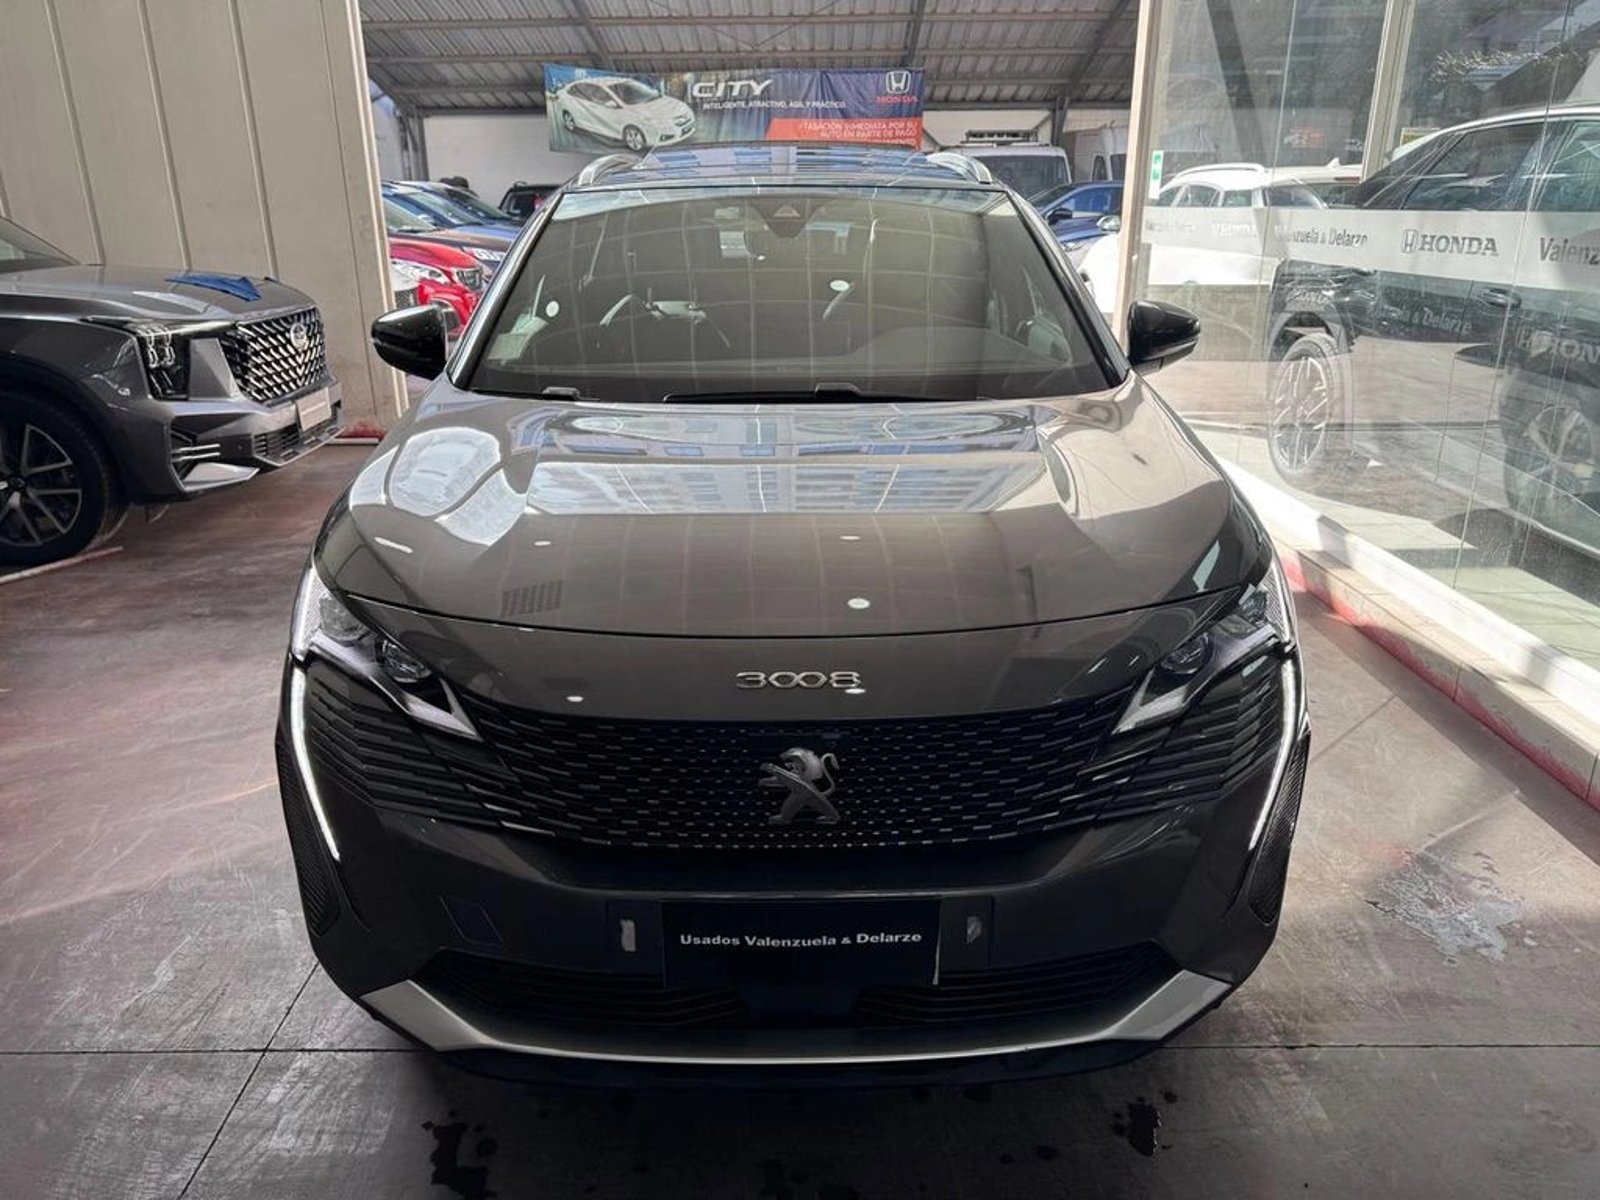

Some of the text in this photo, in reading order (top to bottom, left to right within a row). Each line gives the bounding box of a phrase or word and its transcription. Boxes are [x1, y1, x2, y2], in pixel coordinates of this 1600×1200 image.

[692, 79, 773, 98] CITY
[1419, 234, 1499, 257] HONDA
[736, 671, 861, 688] 3008
[680, 932, 922, 947] Usados Valenzuela & Delarze
